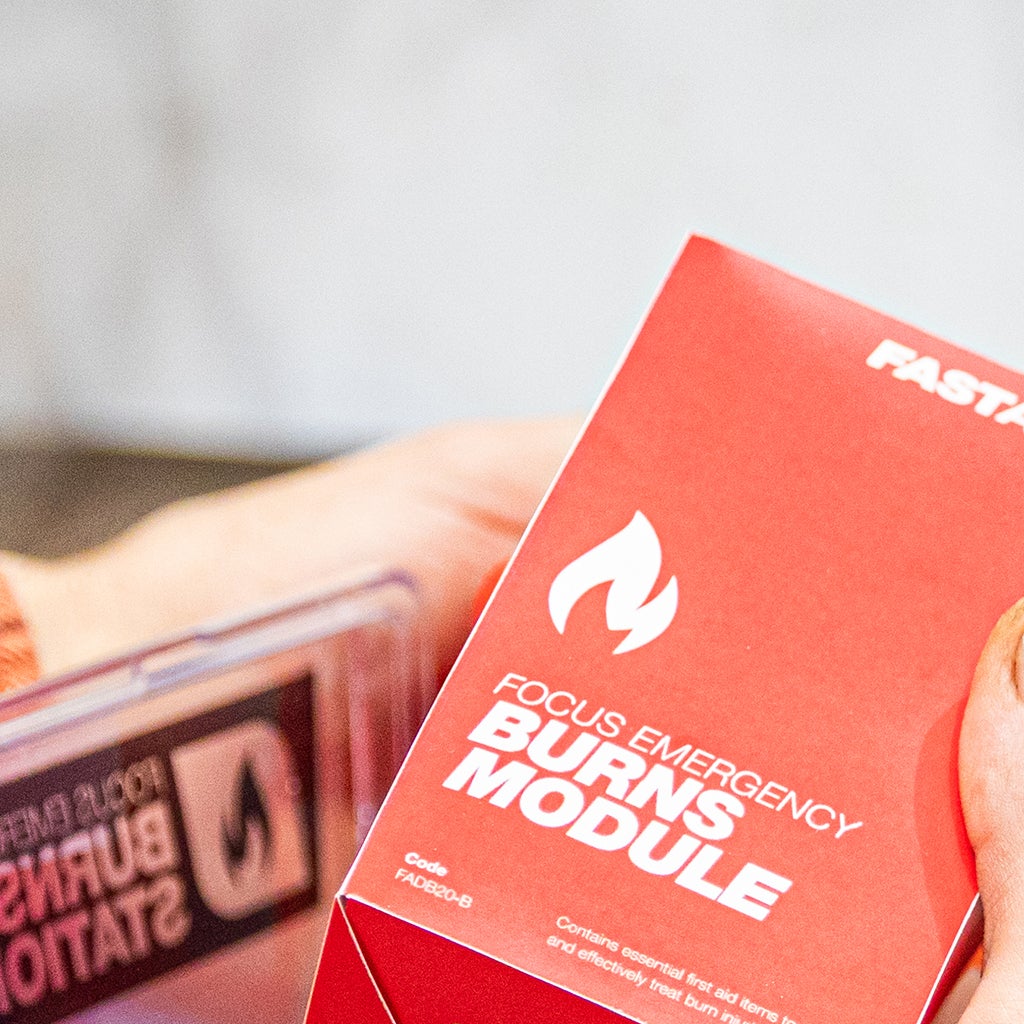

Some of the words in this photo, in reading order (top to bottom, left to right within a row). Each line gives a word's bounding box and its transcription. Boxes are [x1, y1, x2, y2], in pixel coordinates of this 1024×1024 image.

[467, 700, 745, 840] BURNS
[493, 673, 626, 737] FOCUS
[628, 725, 863, 839] EMERGENCY
[394, 868, 474, 908] FADB20-B
[404, 852, 448, 877] Code
[442, 747, 793, 922] MODULE
[546, 934, 576, 955] and
[577, 947, 649, 988] effectively
[649, 979, 683, 1003] treat
[683, 992, 720, 1018] burn
[556, 916, 620, 953] Contains
[621, 946, 686, 981] essential
[684, 971, 713, 993] first
[714, 982, 739, 1005] aid
[739, 994, 778, 1023] items
